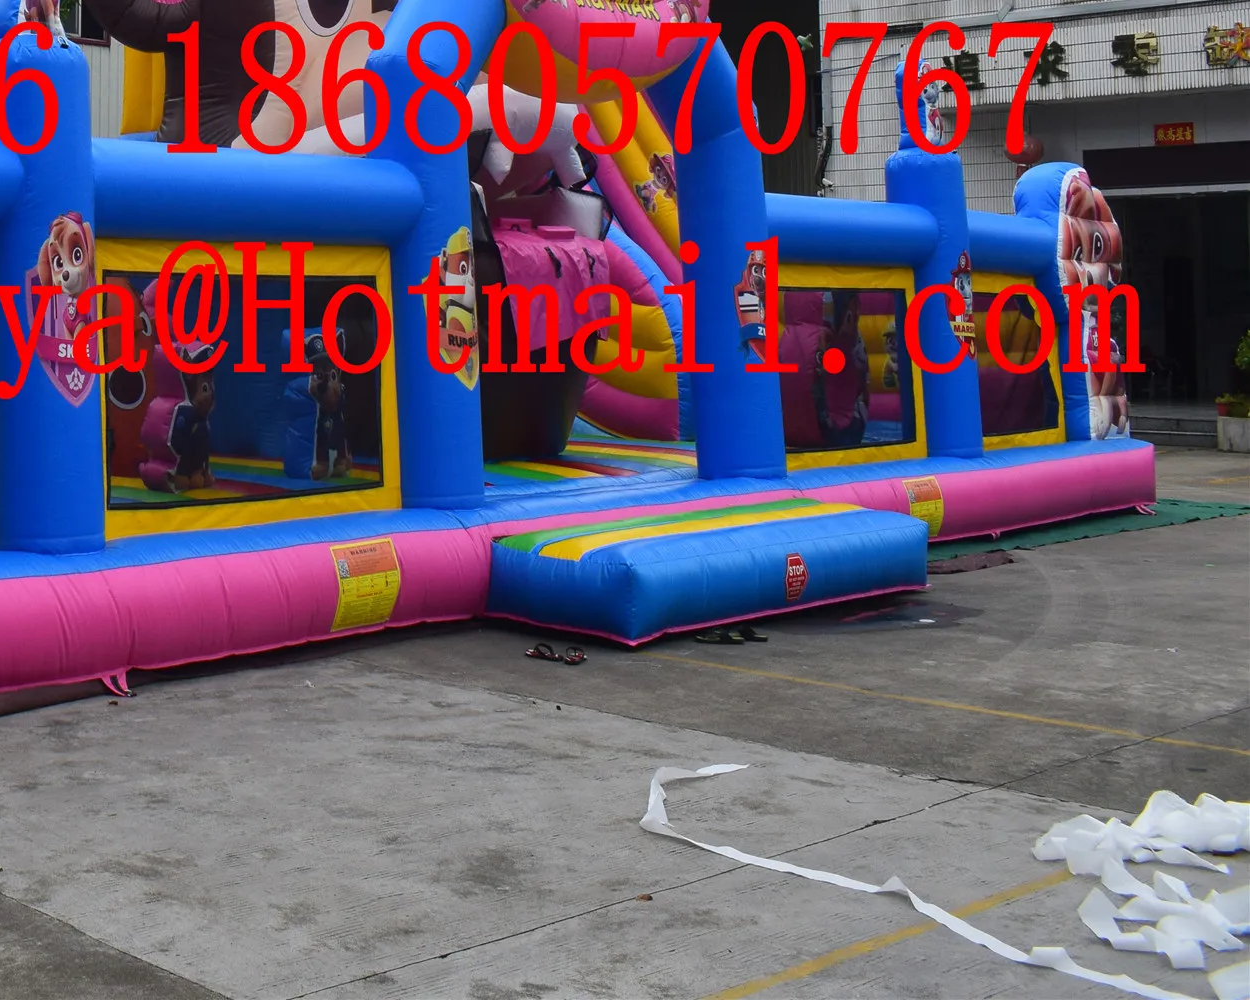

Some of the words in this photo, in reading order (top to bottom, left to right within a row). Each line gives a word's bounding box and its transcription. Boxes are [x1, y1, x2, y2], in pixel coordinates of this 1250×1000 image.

[447, 333, 478, 349] RUBBL
[350, 547, 377, 556] WARNING
[789, 565, 804, 576] STOP
